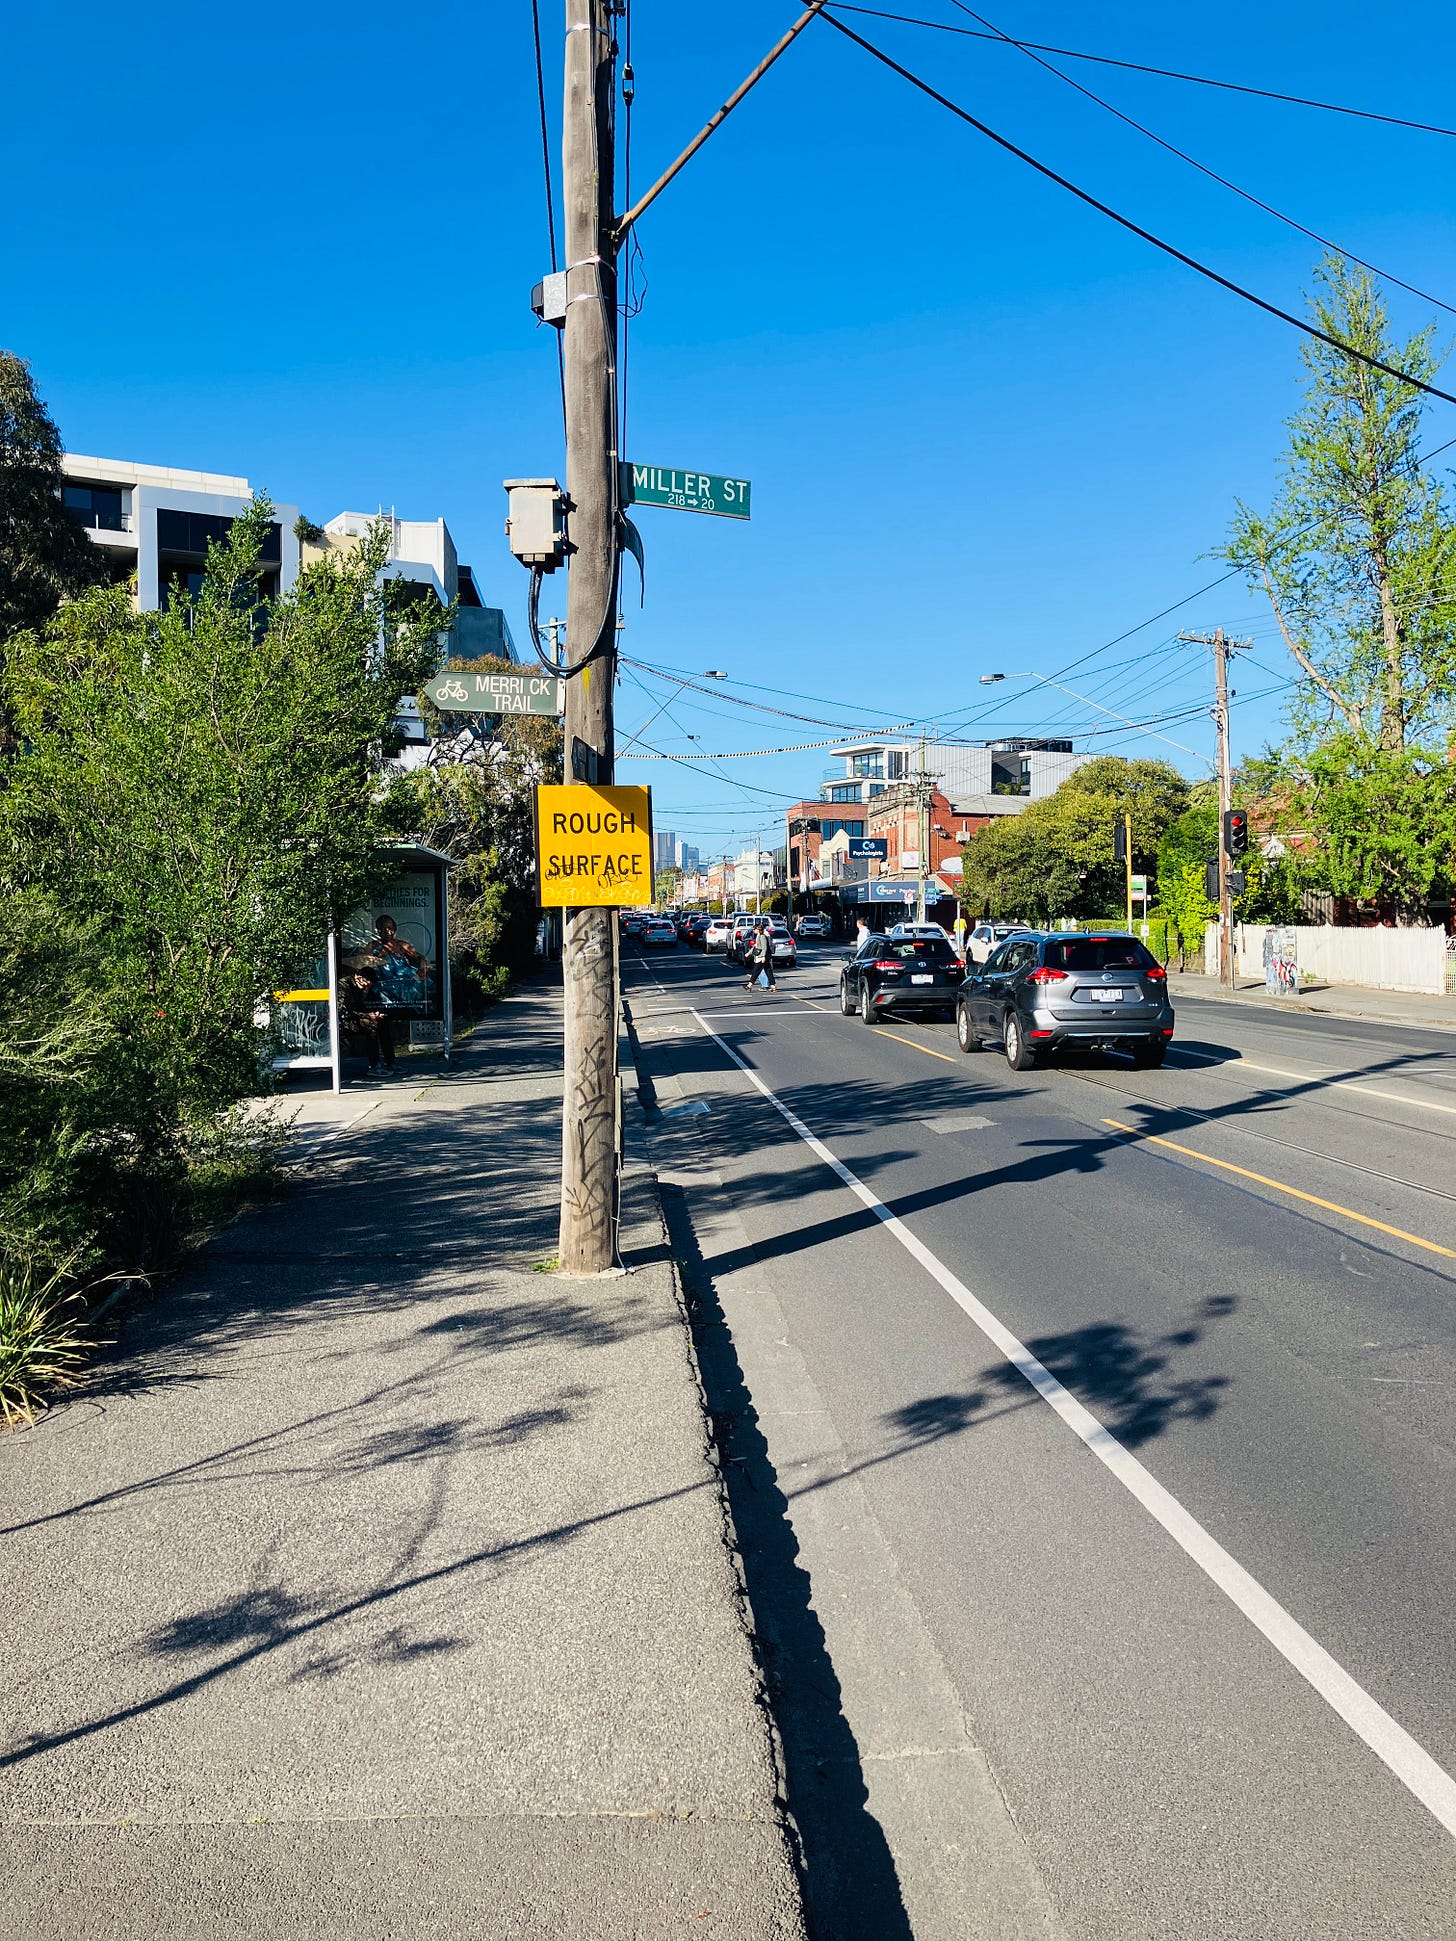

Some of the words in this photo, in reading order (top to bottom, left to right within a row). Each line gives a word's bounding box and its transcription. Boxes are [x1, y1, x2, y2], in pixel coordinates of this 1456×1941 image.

[633, 466, 711, 498] MILLER
[723, 480, 748, 503] ST
[667, 493, 686, 506] 218
[701, 498, 715, 510] 20
[475, 675, 524, 694] MERRI
[529, 678, 551, 695] CK
[492, 694, 536, 712] TRAIL
[553, 812, 635, 834] ROUGH
[549, 854, 642, 876] SURFACE
[412, 887, 430, 897] FOR
[373, 897, 430, 908] BEGINNINGS.
